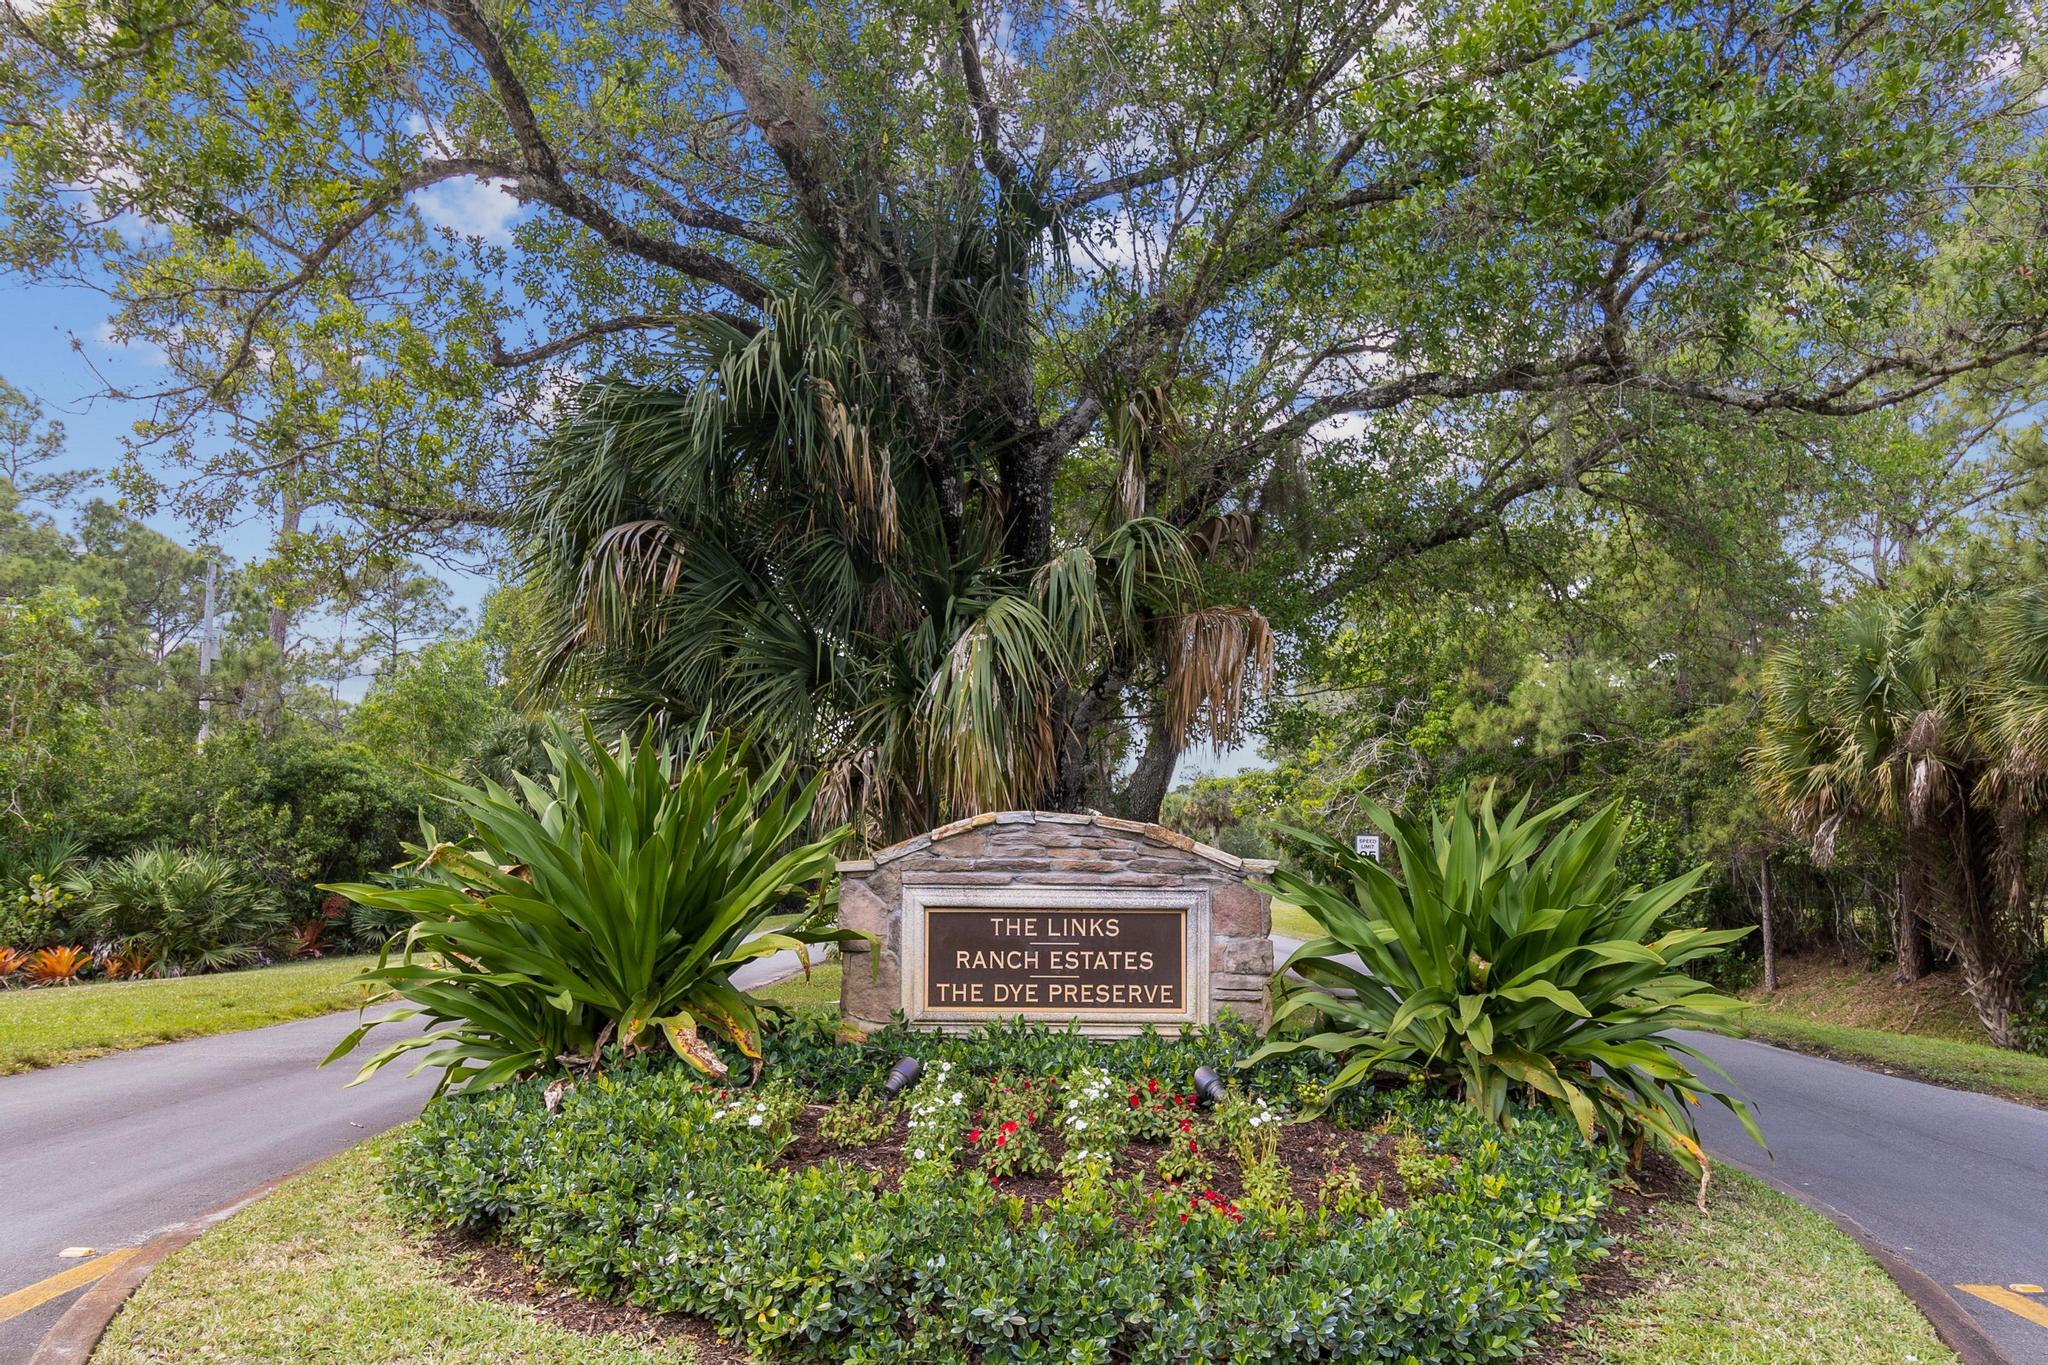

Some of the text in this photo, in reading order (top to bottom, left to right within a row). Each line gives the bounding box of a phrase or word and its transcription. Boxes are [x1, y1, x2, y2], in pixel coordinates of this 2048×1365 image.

[990, 918, 1120, 937] THE LINKS
[956, 950, 1154, 970] RANCH ESTATES
[936, 983, 1174, 1004] THE DYE PRESERVE
